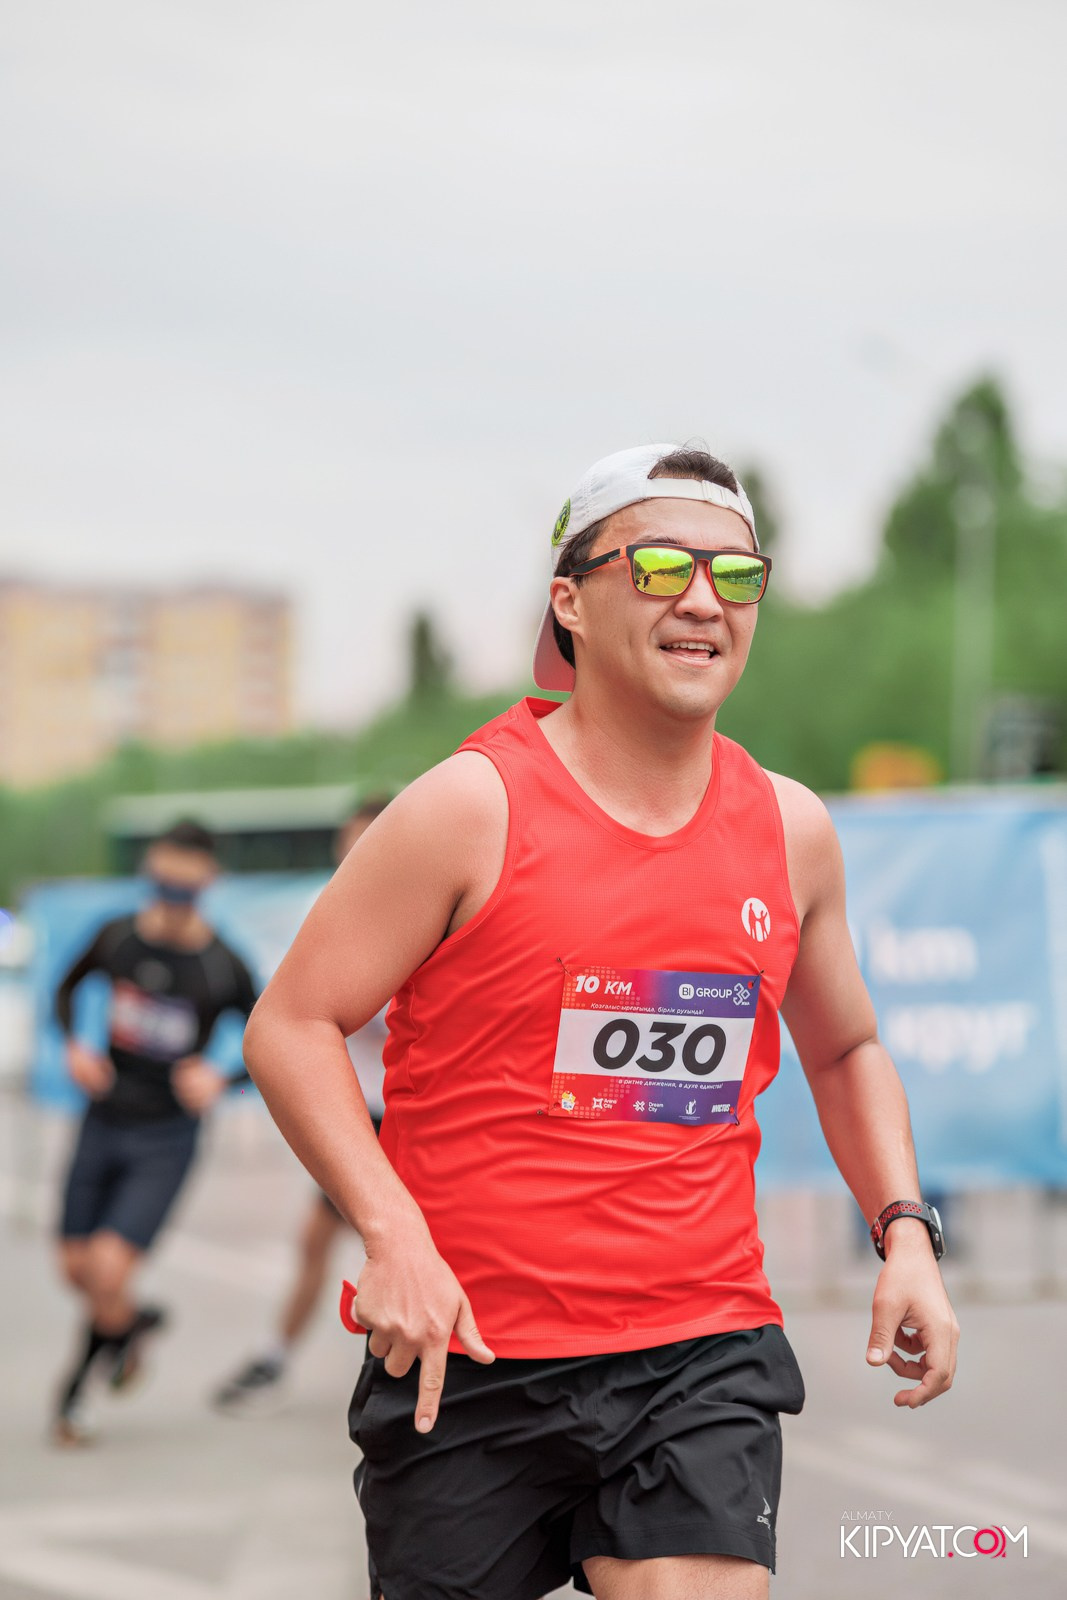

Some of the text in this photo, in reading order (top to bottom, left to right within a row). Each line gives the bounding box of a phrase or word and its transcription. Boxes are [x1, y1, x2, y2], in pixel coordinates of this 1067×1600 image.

[575, 975, 600, 994] 10
[696, 987, 733, 998] GROUP
[593, 1018, 727, 1076] 030
